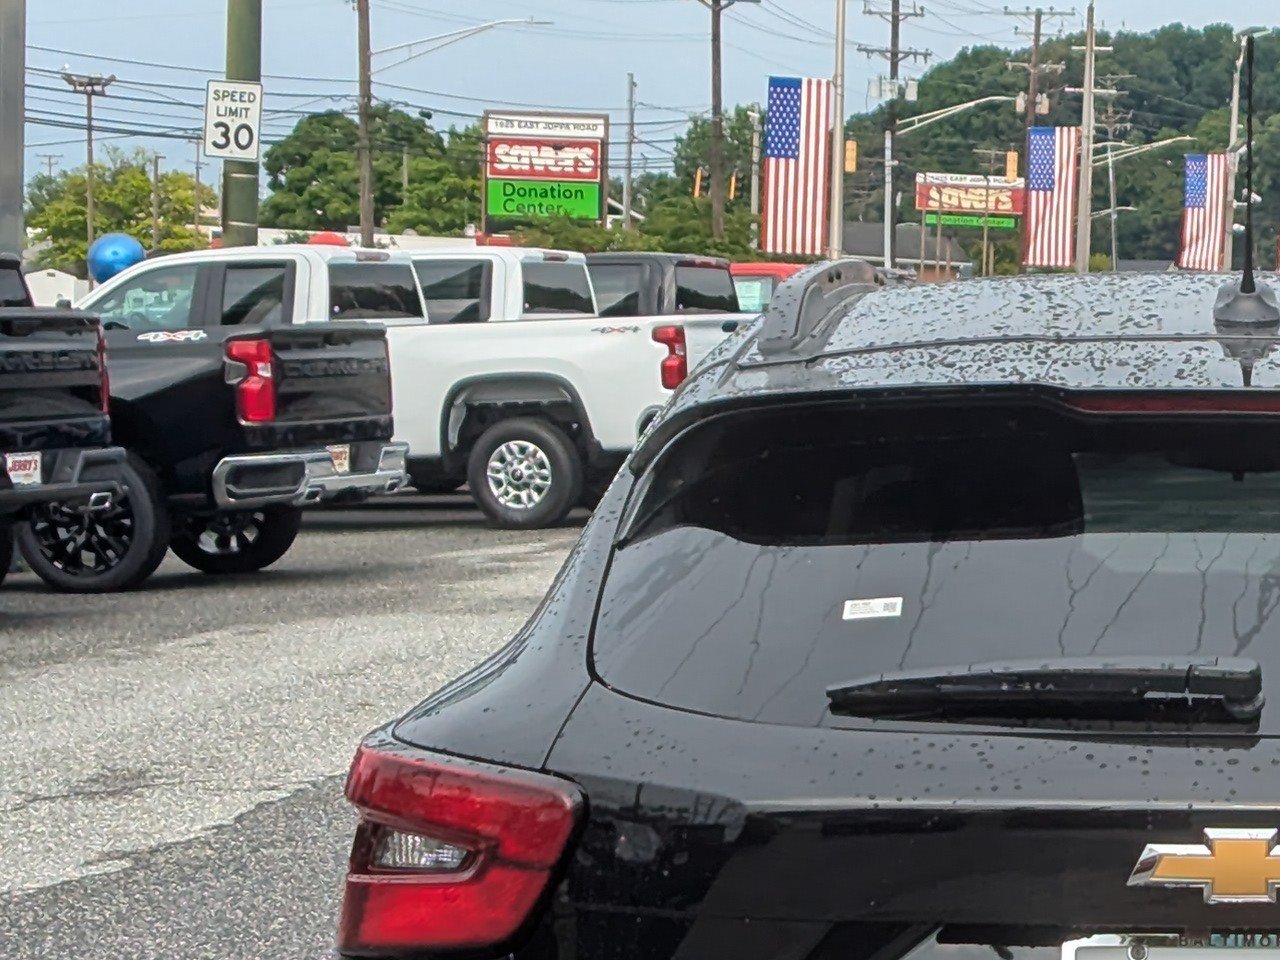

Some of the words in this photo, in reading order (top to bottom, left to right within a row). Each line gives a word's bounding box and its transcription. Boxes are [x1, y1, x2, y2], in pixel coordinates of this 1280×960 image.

[212, 89, 256, 103] SPEED
[216, 105, 250, 118] LIMIT
[518, 120, 540, 130] EAST
[573, 122, 598, 132] ROAD
[211, 121, 254, 150] 30
[502, 182, 585, 199] Donation
[502, 199, 564, 214] Center
